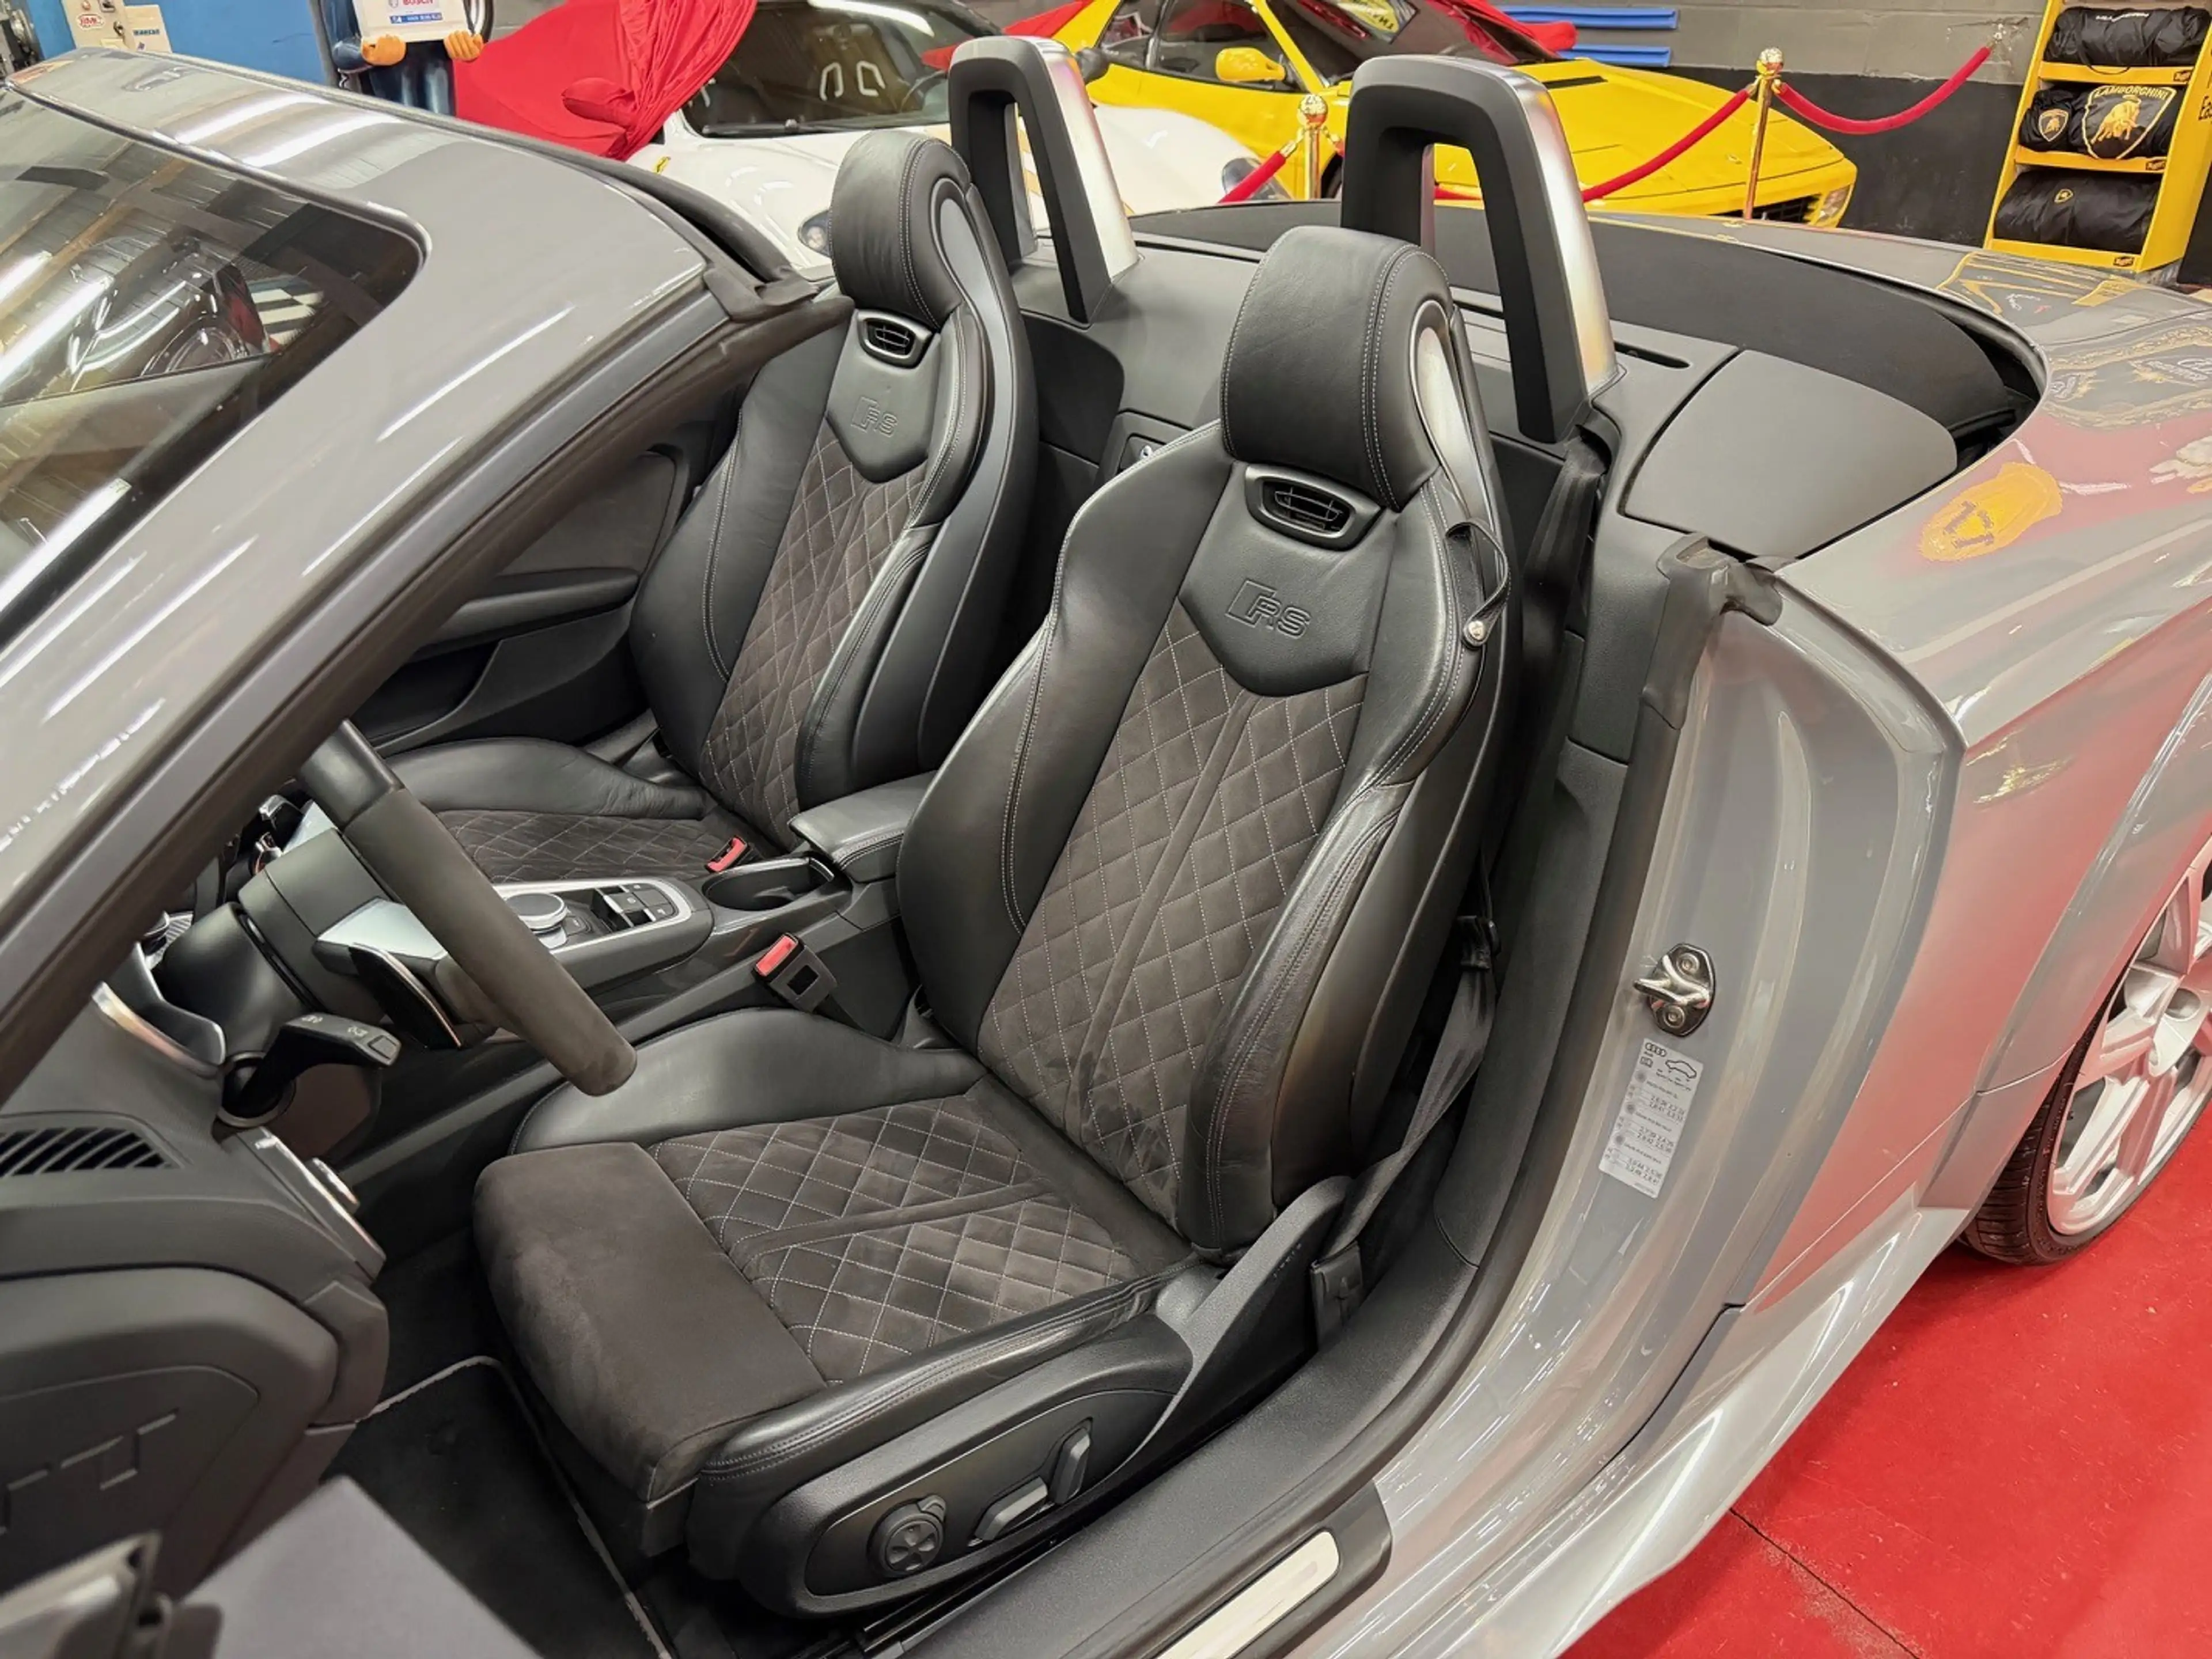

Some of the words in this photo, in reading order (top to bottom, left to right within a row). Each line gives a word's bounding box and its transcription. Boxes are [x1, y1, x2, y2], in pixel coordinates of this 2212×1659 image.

[2094, 86, 2169, 100] LAMBORGHINI
[850, 396, 899, 438] RS
[1224, 577, 1312, 639] RS
